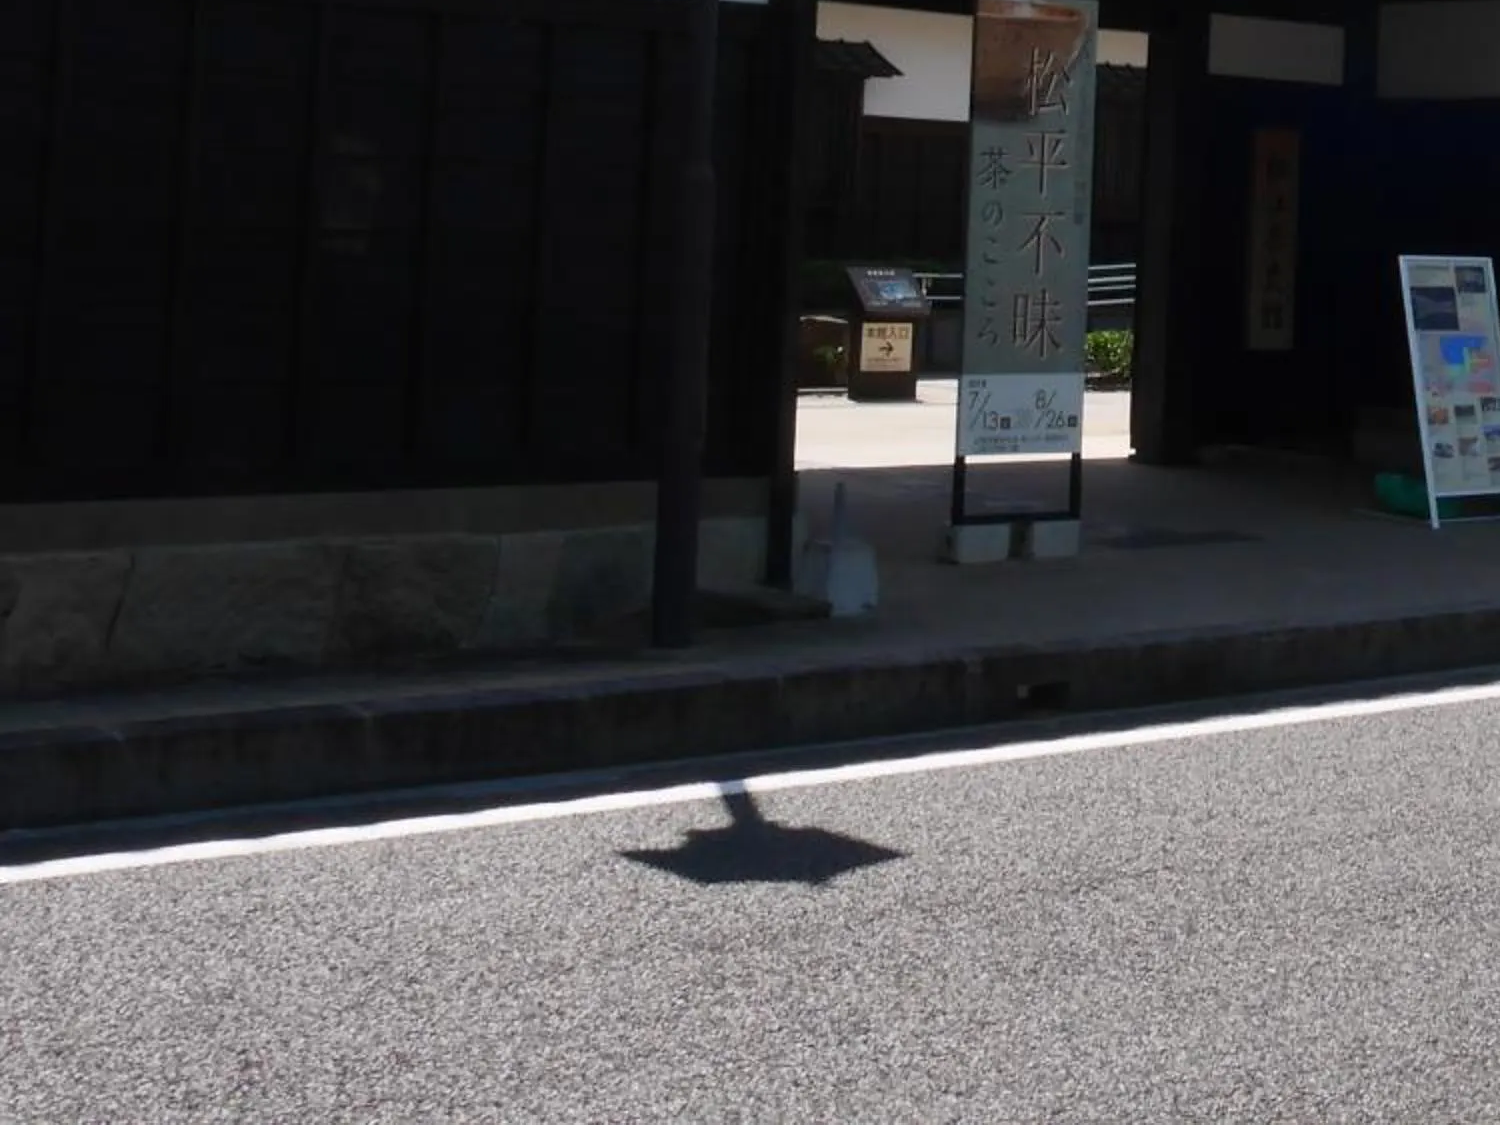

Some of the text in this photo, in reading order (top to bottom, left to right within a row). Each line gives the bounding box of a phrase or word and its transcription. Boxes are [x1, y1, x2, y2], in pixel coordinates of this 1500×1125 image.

[975, 146, 1012, 347] 茶のこころ
[1011, 47, 1073, 359] 松平不昧
